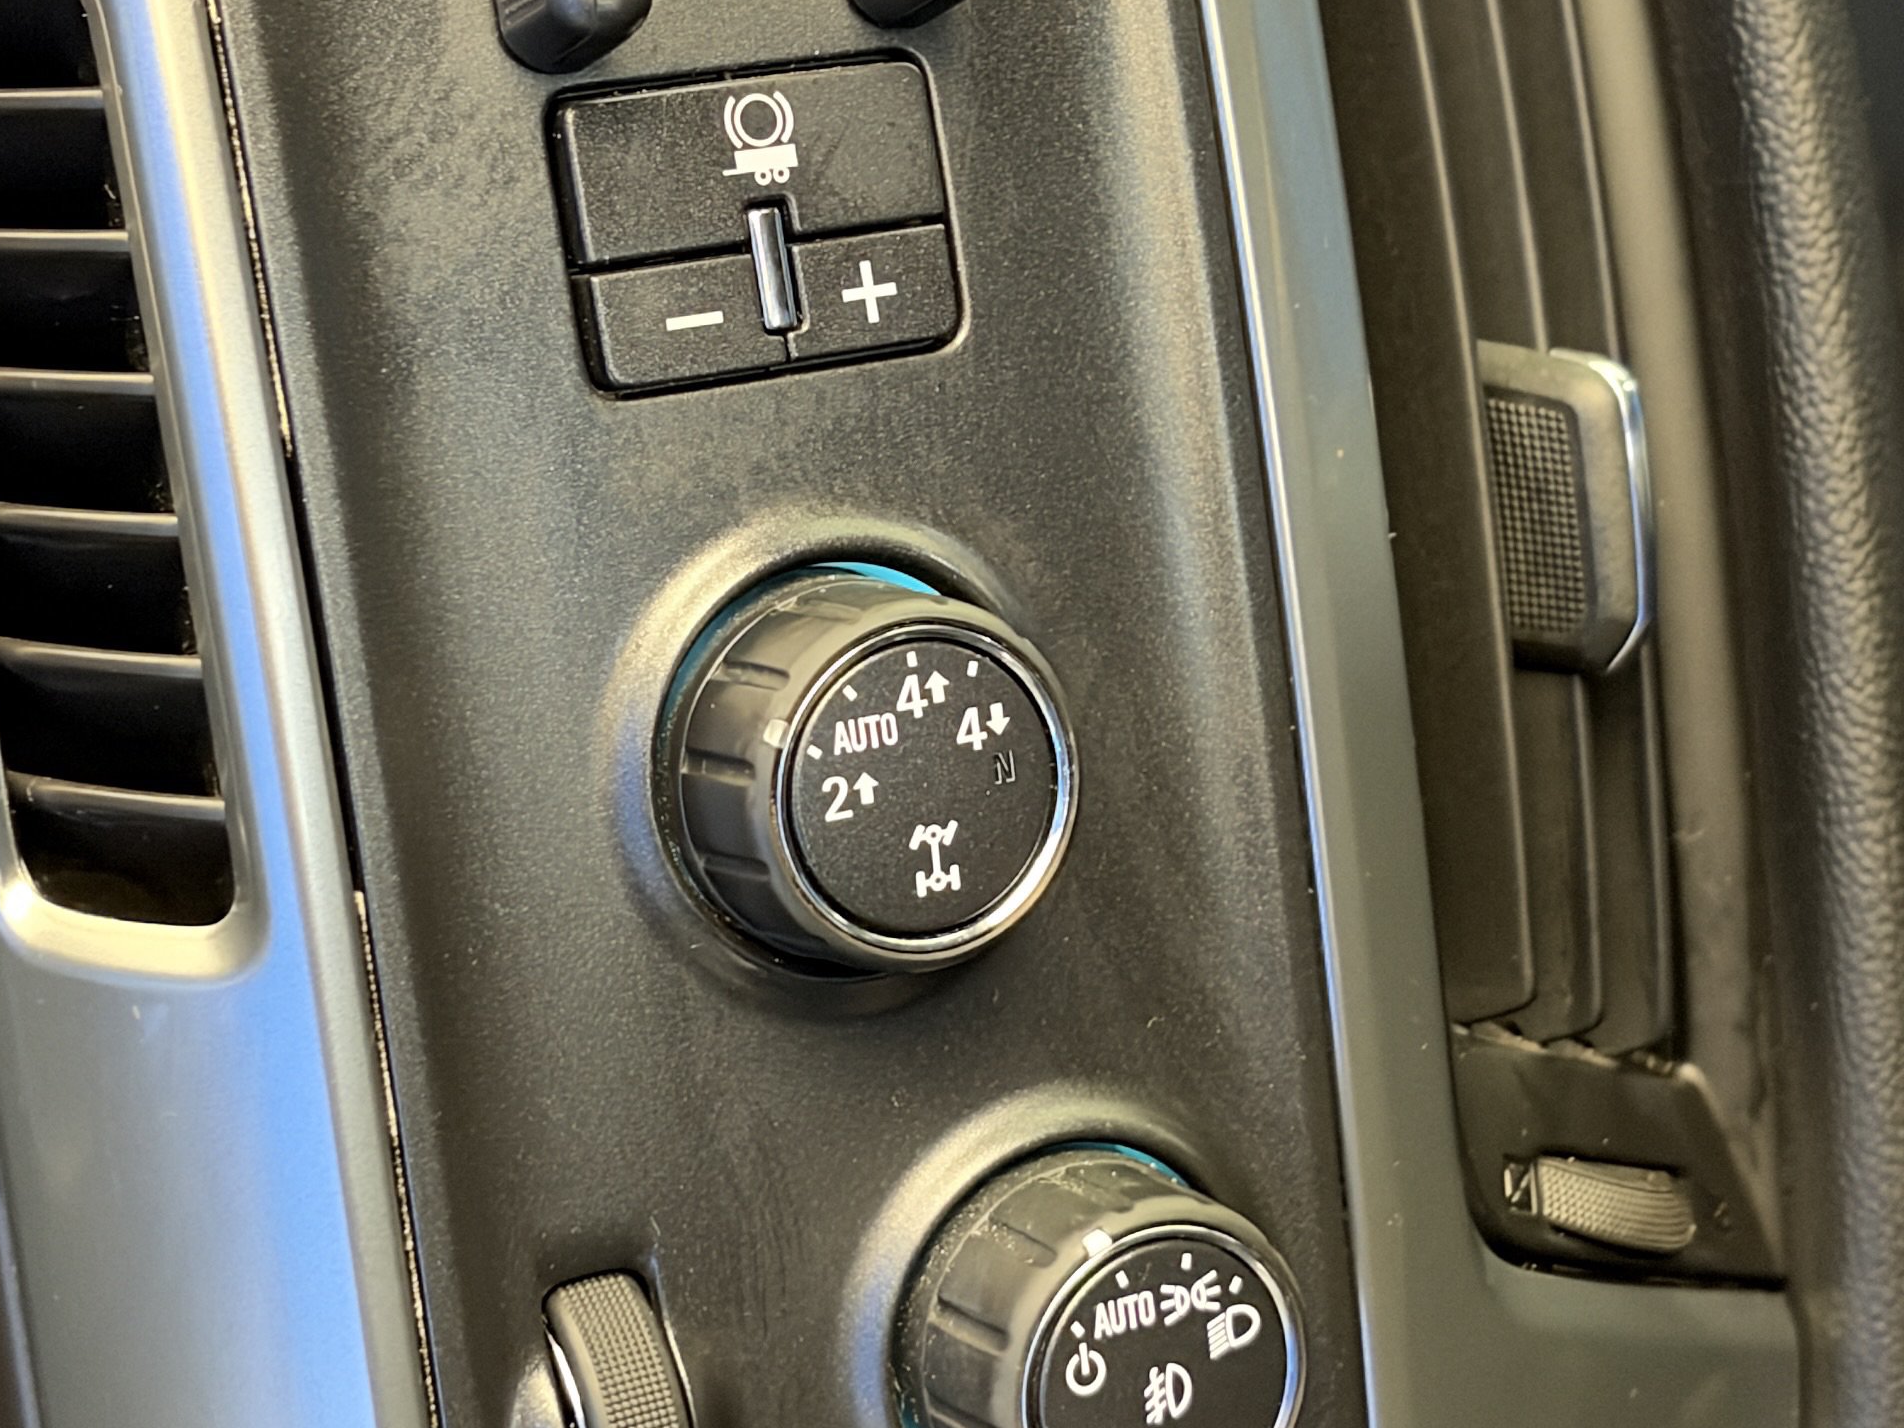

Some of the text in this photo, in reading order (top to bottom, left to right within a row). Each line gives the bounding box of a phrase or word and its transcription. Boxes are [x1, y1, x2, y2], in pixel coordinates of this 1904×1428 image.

[896, 674, 928, 719] 4
[833, 711, 899, 756] AUTO
[956, 706, 988, 751] 4
[993, 748, 1017, 786] N
[821, 776, 853, 822] 2
[1093, 1289, 1157, 1341] AUTO
